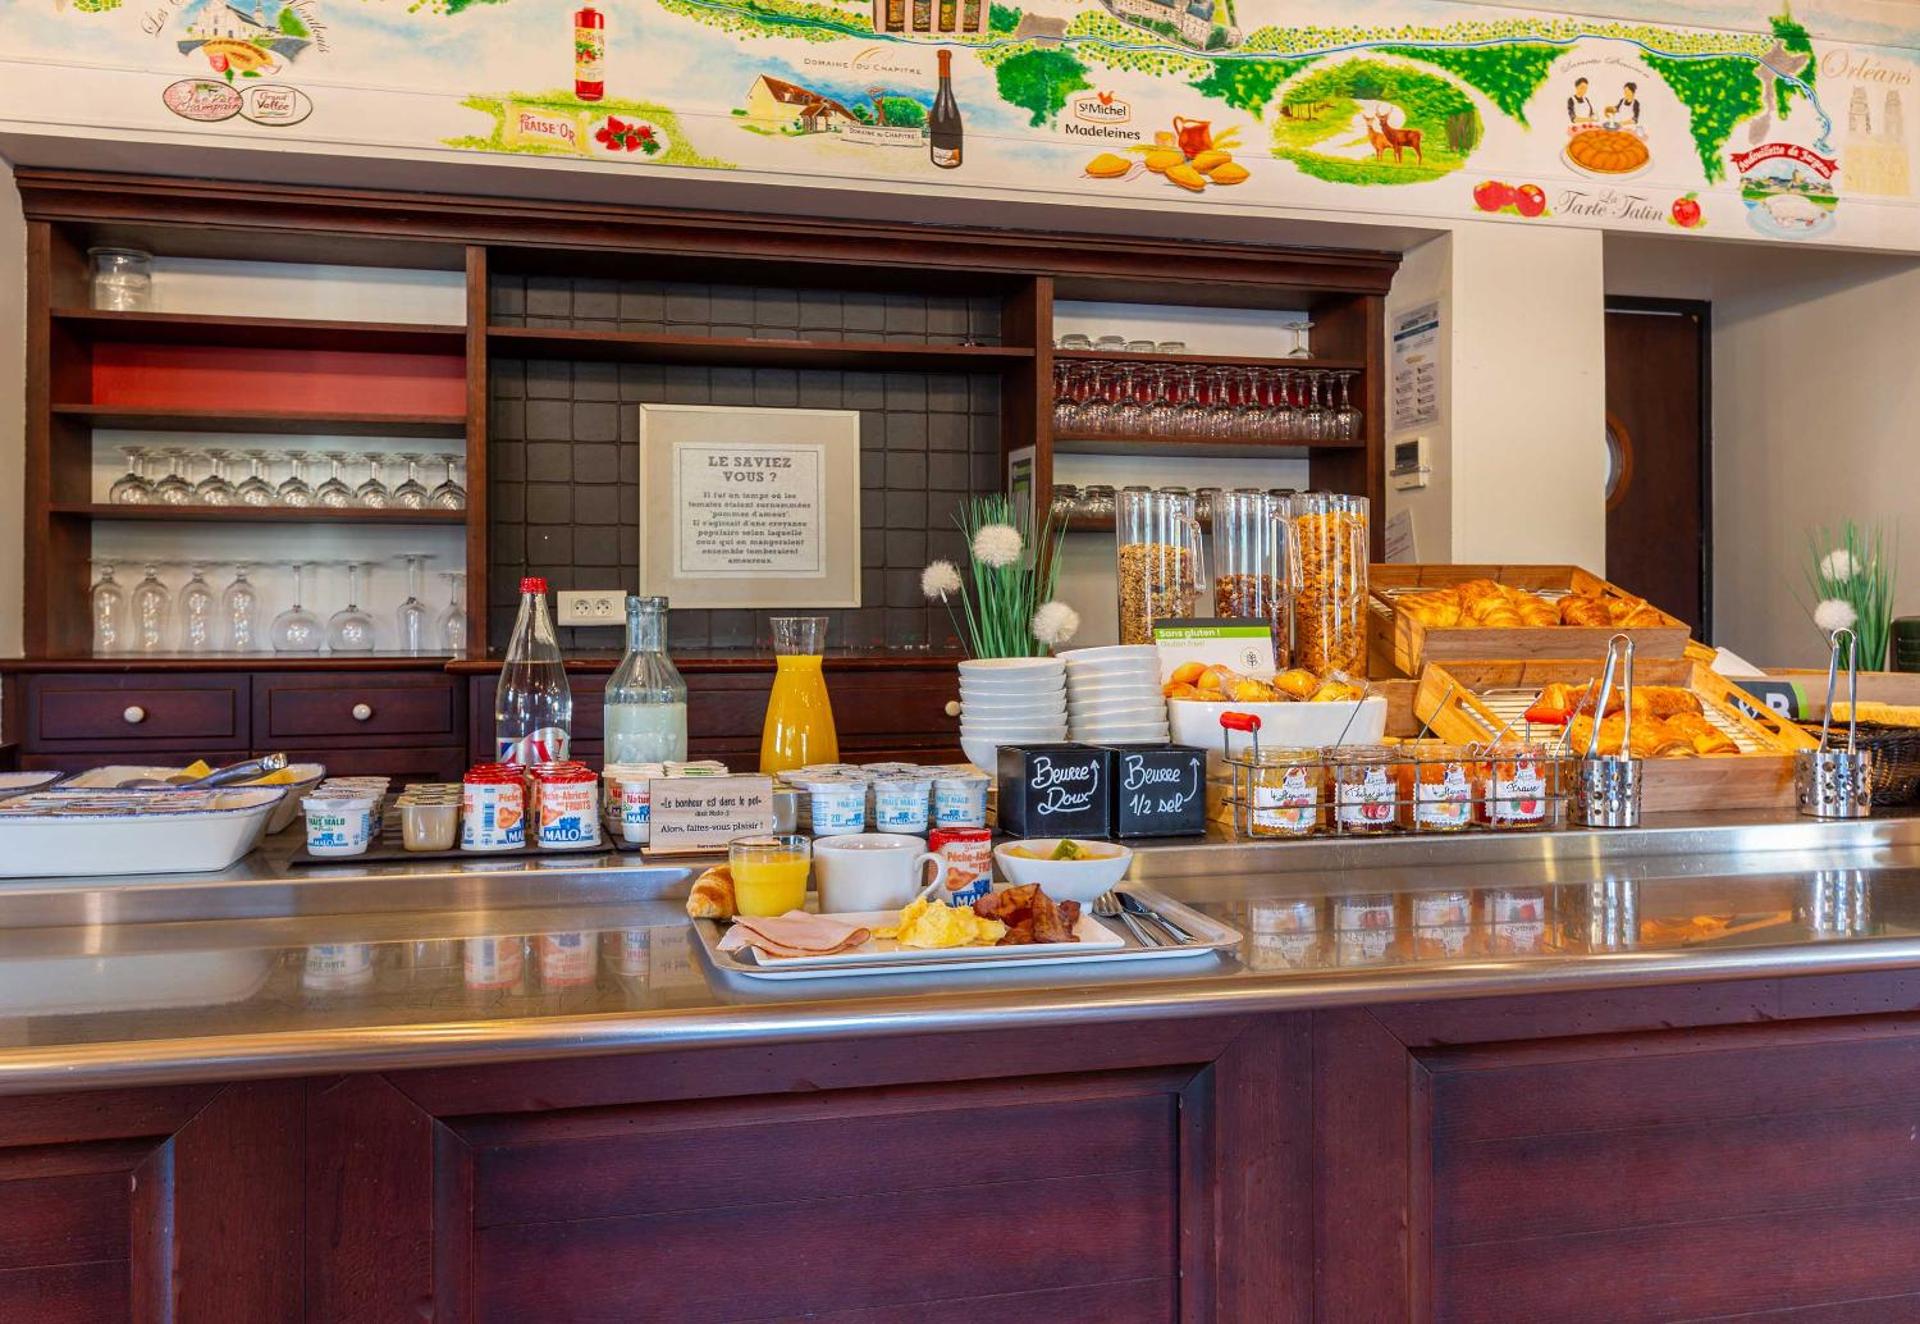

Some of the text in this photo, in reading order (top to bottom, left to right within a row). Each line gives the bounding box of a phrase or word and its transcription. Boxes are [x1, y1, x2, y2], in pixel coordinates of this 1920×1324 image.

[803, 57, 923, 76] DOMAINE DU CHAPITRE
[1821, 49, 1912, 86] Orléans
[1065, 123, 1141, 141] Madeleines
[1612, 194, 1664, 220] Tatin
[708, 456, 792, 468] LE SAVIEZ
[722, 471, 777, 482] VOUS ?
[719, 538, 734, 547] qui
[1159, 629, 1183, 638] Sans
[1185, 628, 1217, 639] gluten
[1031, 755, 1090, 789] Beurre
[1123, 754, 1181, 790] Beurre
[675, 797, 703, 808] bonheur
[720, 796, 736, 807] dans
[1037, 787, 1092, 815] Doux
[1129, 793, 1184, 816] 1/2 sel
[545, 829, 580, 841] MALO
[687, 823, 731, 833] faites-vous
[732, 821, 758, 832] plaisir
